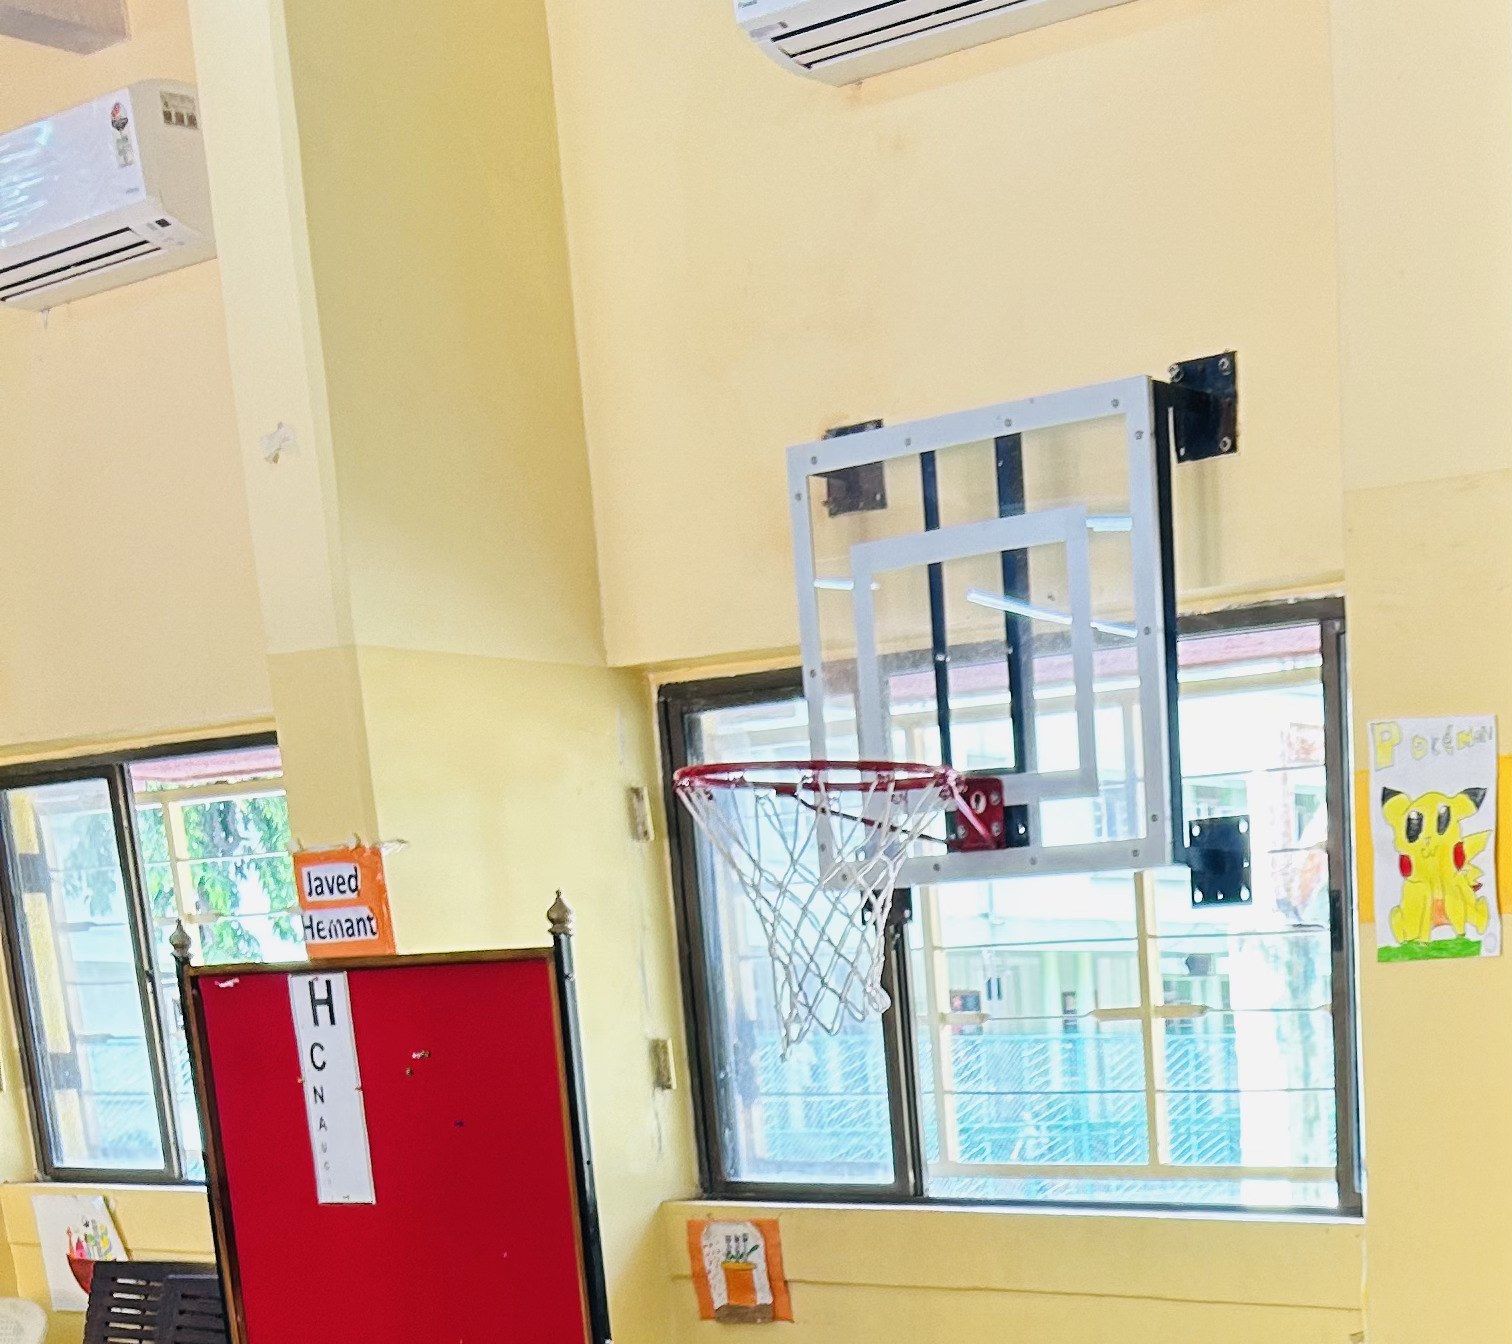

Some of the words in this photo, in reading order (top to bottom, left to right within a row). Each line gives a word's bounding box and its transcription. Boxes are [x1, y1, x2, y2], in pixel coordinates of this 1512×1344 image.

[306, 865, 359, 897] Javed
[301, 914, 377, 940] Hemant
[309, 979, 336, 1027] H
[310, 1042, 326, 1071] C
[313, 1085, 325, 1104] N
[319, 1116, 328, 1131] A
